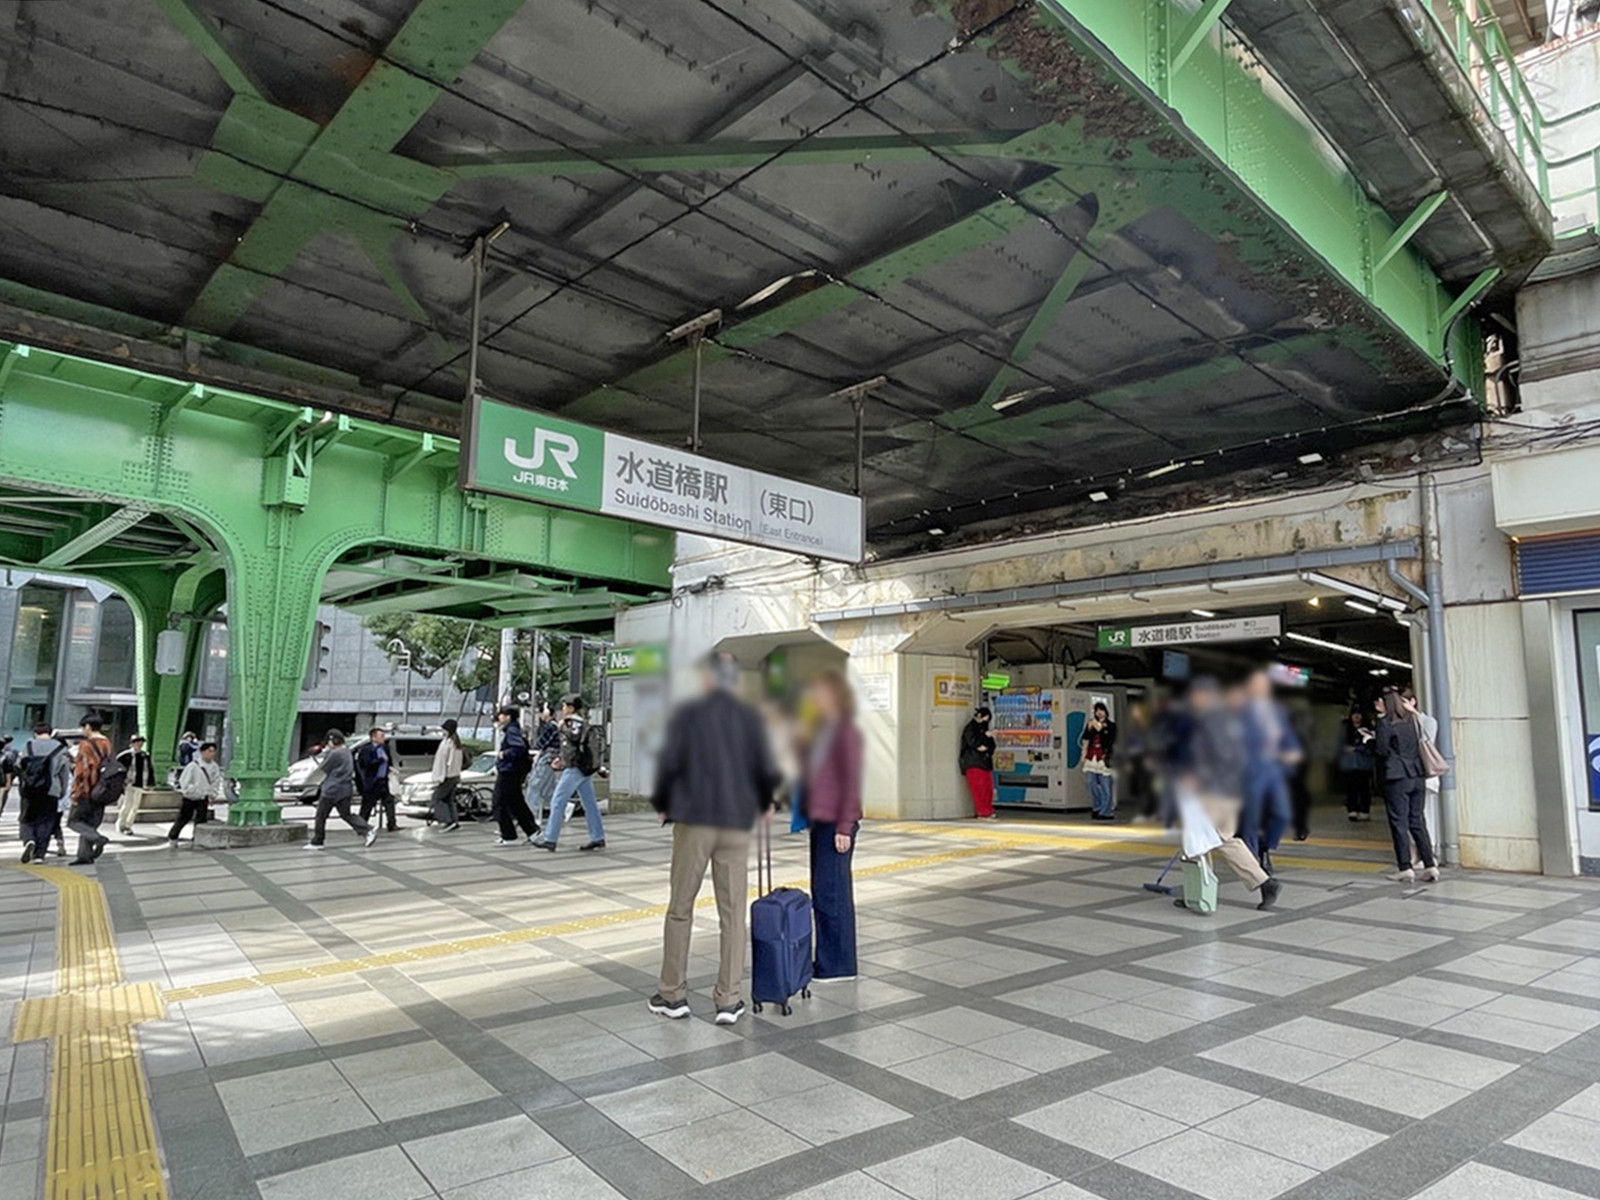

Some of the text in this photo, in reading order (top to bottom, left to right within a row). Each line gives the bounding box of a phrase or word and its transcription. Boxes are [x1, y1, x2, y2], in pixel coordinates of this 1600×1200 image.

[504, 427, 579, 479] JR
[513, 471, 569, 491] JR東日本
[616, 451, 728, 505] 水道橋駅
[614, 488, 752, 532] Suidōbashi Station
[1108, 631, 1126, 642] JR
[1138, 626, 1193, 643] 水道橋駅
